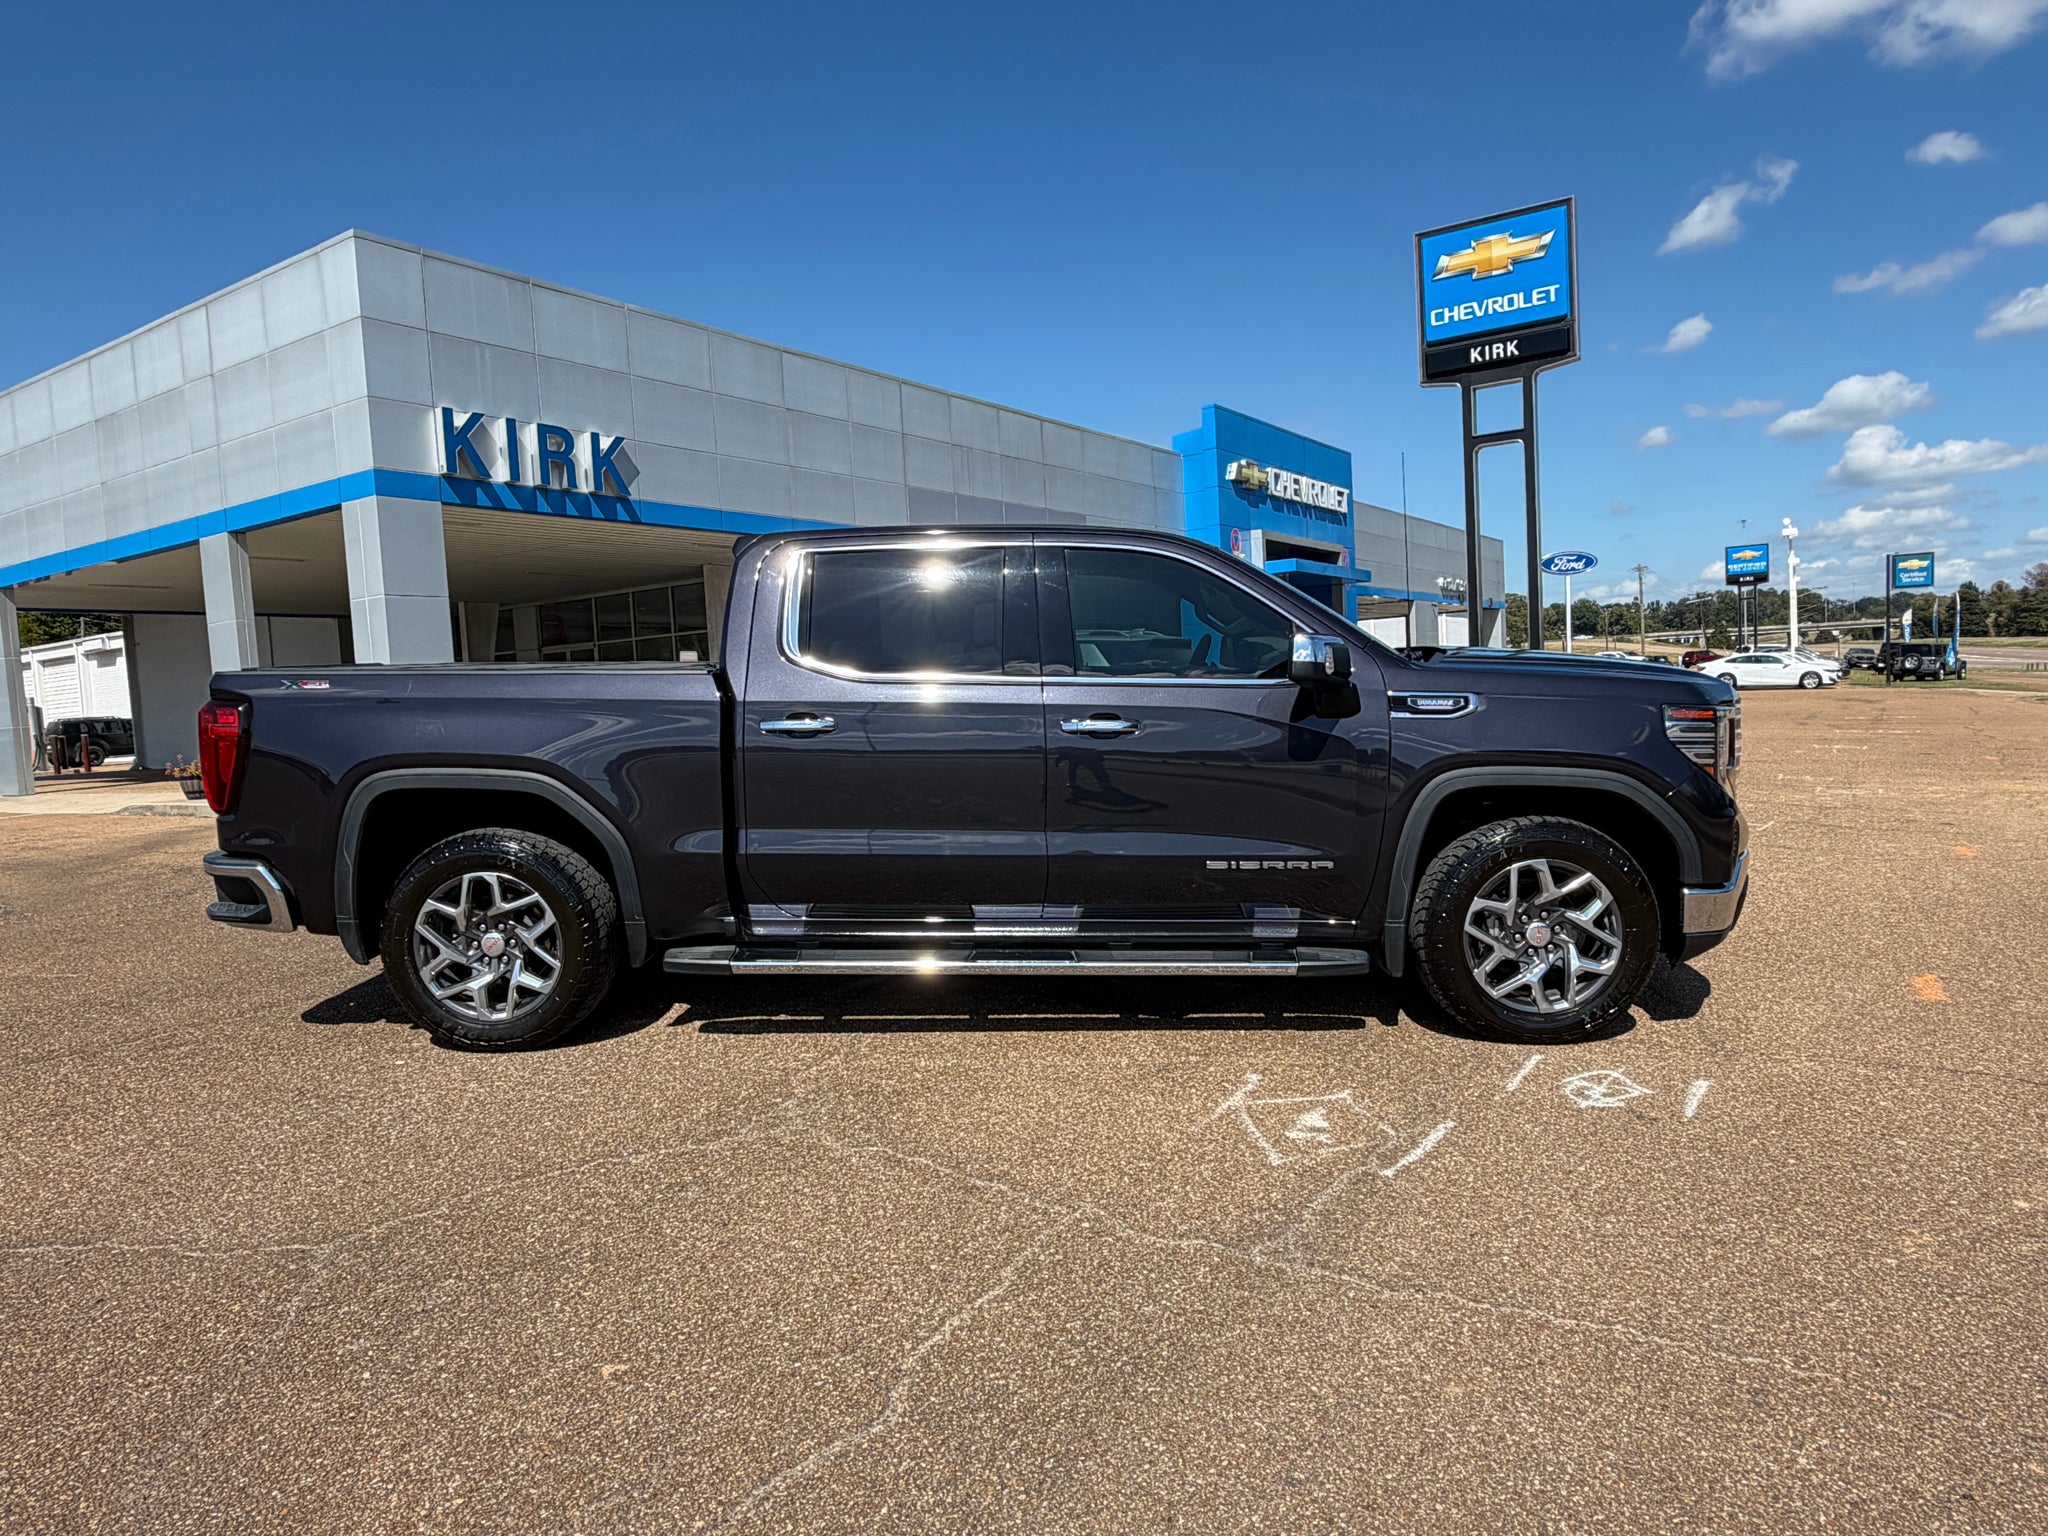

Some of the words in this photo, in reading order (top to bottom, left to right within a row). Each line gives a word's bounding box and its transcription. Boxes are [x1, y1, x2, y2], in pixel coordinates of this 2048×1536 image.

[1430, 284, 1560, 327] CHEVROLET
[1470, 339, 1520, 363] KIRK
[437, 406, 634, 497] KIRK
[1267, 467, 1350, 513] CHEVROLET
[1550, 555, 1587, 571] Ford
[1206, 860, 1335, 870] SIERRA
